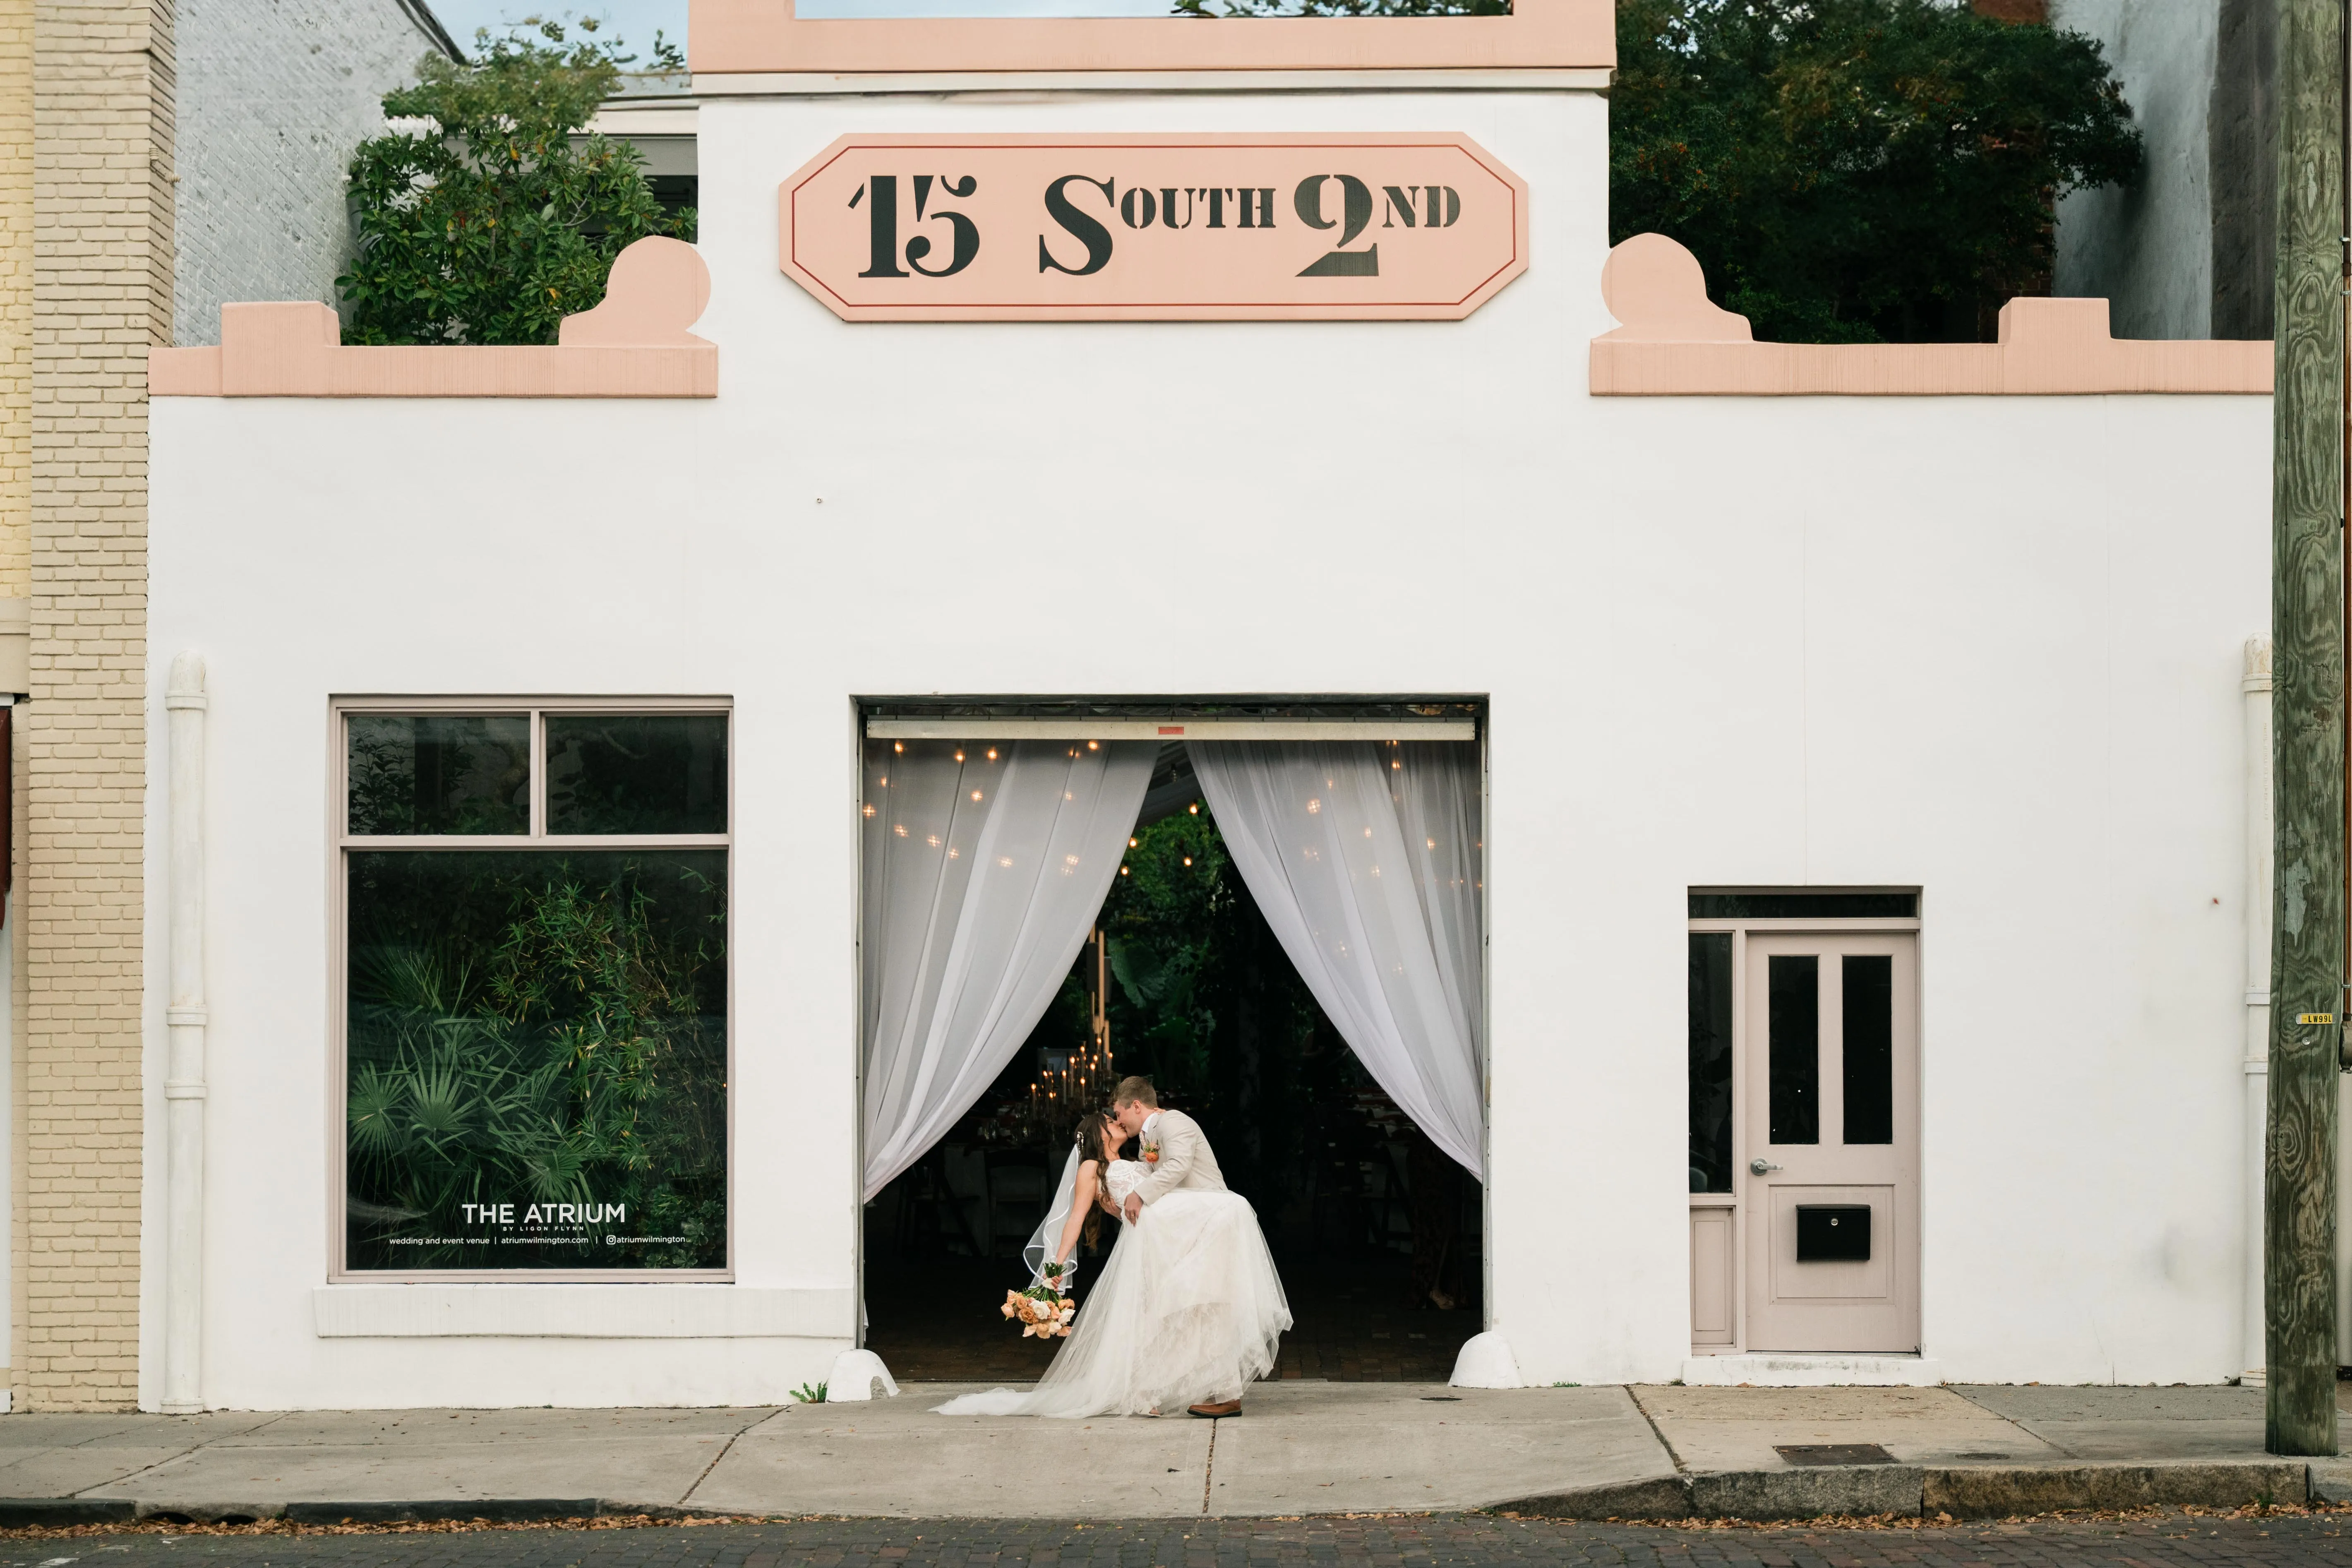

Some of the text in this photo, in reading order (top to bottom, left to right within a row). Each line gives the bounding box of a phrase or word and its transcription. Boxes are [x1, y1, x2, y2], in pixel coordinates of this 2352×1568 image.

[848, 175, 979, 278] 15
[462, 1204, 624, 1223] THE ATRIUM
[389, 1237, 423, 1245] wedding
